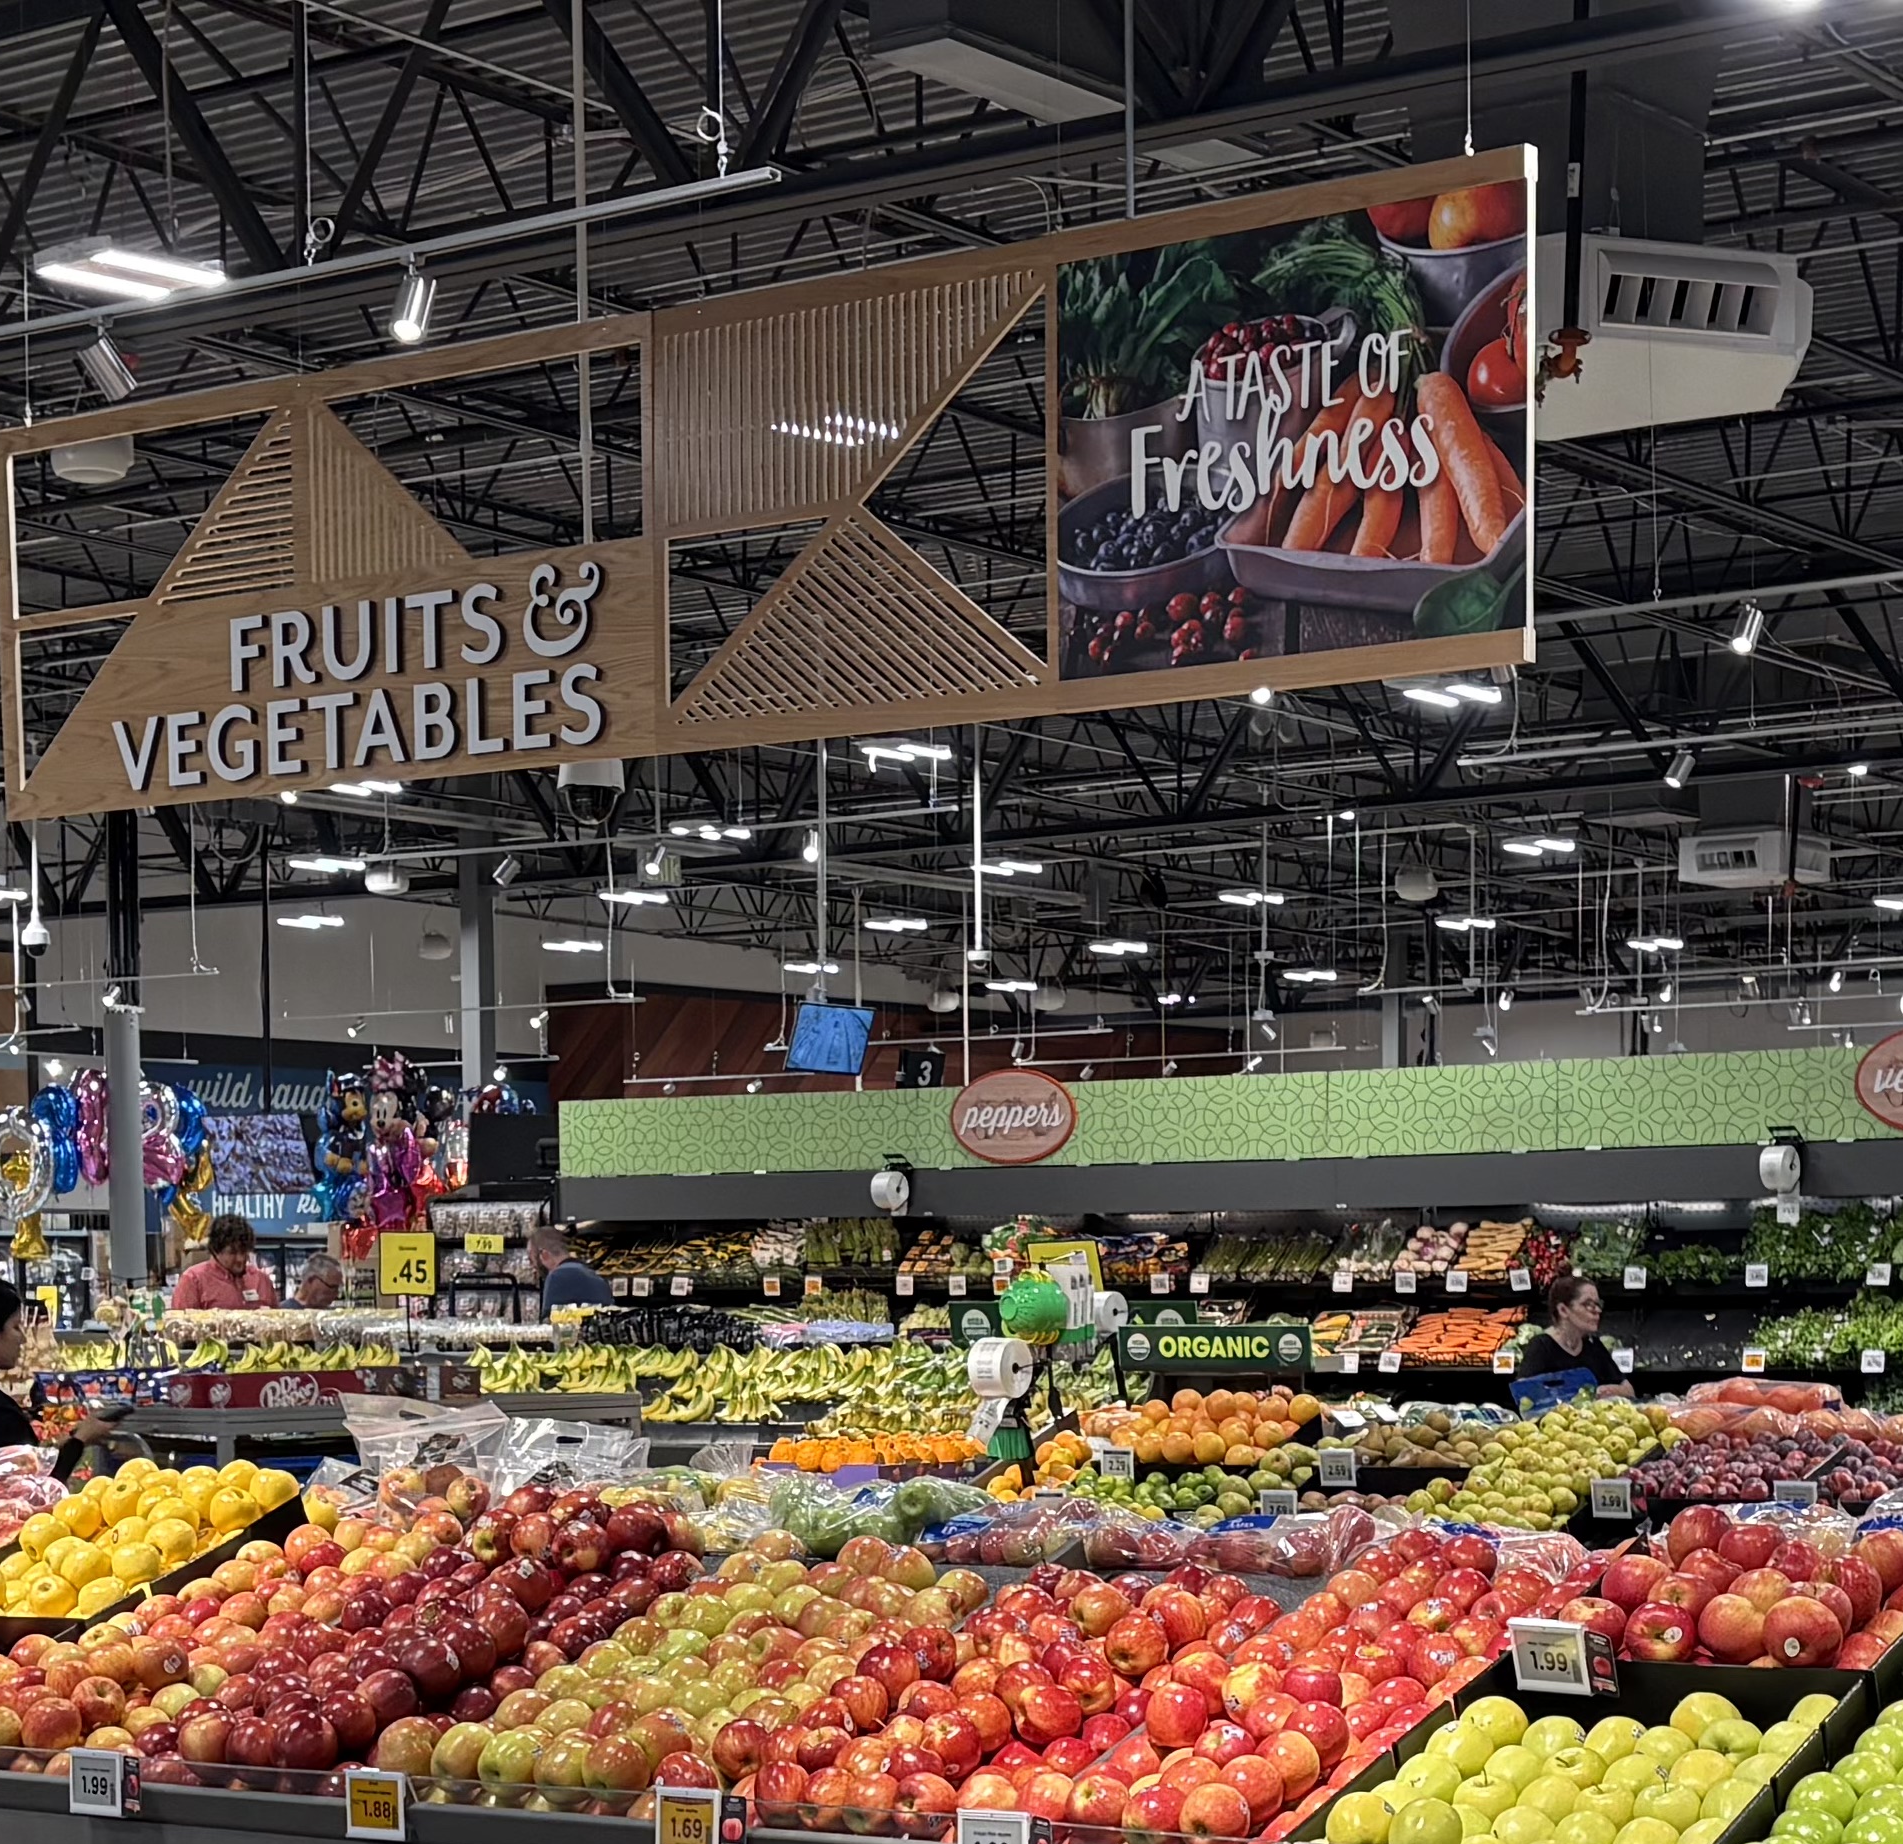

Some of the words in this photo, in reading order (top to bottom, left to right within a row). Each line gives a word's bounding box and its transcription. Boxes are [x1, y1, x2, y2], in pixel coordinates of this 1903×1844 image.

[1219, 333, 1345, 421] TASTE
[1359, 328, 1412, 397] OF
[1130, 390, 1441, 519] Freshness
[229, 583, 503, 692] FRUITS
[522, 561, 600, 657] &
[112, 663, 601, 791] VEGETABLES
[917, 1061, 932, 1087] 3
[960, 1096, 1064, 1135] peppers
[211, 1192, 285, 1219] HEALTHY
[392, 1258, 428, 1284] .45
[1158, 1335, 1270, 1359] ORGANIC
[1530, 1650, 1569, 1673] 1.99
[81, 1775, 108, 1796] 1.99
[362, 1801, 391, 1820] 1.88
[671, 1818, 703, 1840] 1.69
